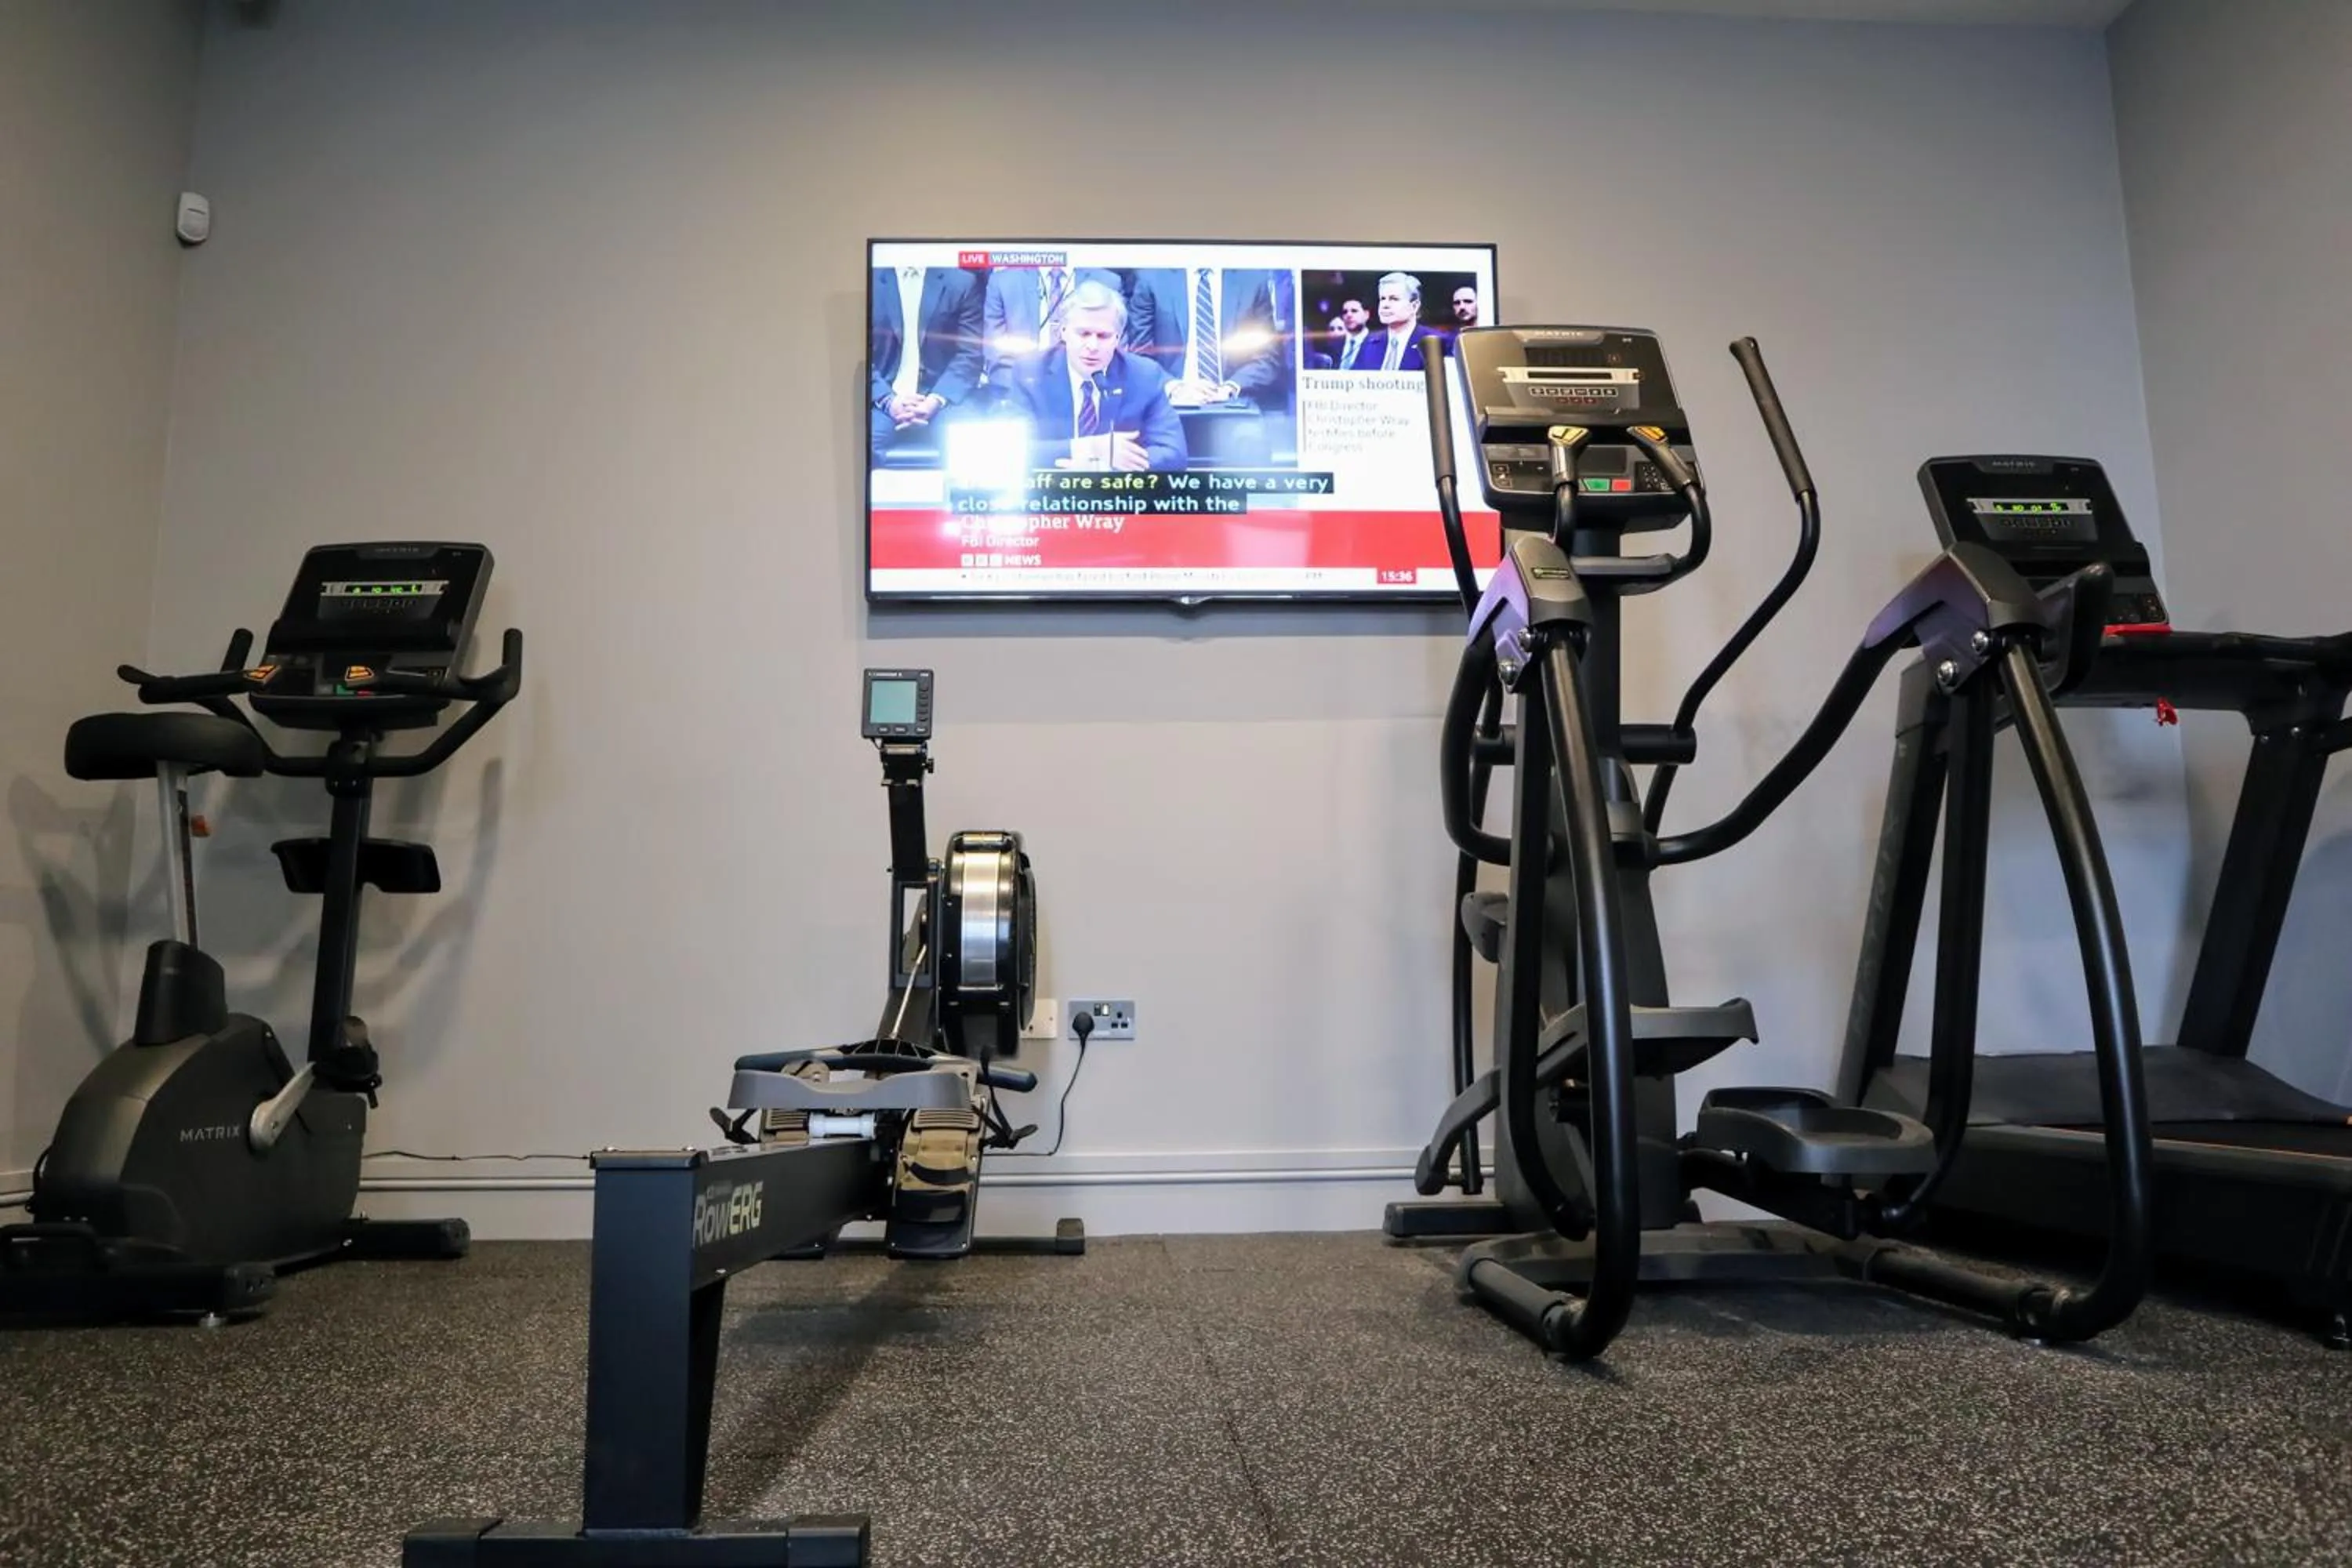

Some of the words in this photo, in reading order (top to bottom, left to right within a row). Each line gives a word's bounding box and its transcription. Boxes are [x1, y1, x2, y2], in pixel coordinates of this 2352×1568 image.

[961, 254, 985, 263] LIVE
[992, 254, 1064, 264] WASHINGTON
[1302, 376, 1354, 392] Trump
[1359, 377, 1425, 393] shooting
[1024, 474, 1053, 488] aff
[1060, 477, 1092, 488] are
[1100, 474, 1158, 488] safe?
[1168, 474, 1200, 488] We
[1209, 474, 1256, 488] have
[1265, 477, 1276, 488] a
[1284, 477, 1329, 494] very
[958, 495, 1000, 510] clo
[1153, 496, 1199, 511] with
[1205, 496, 1240, 511] the
[1075, 515, 1125, 533] Wray
[1004, 554, 1042, 565] NEWS
[180, 1123, 240, 1142] MATRIX
